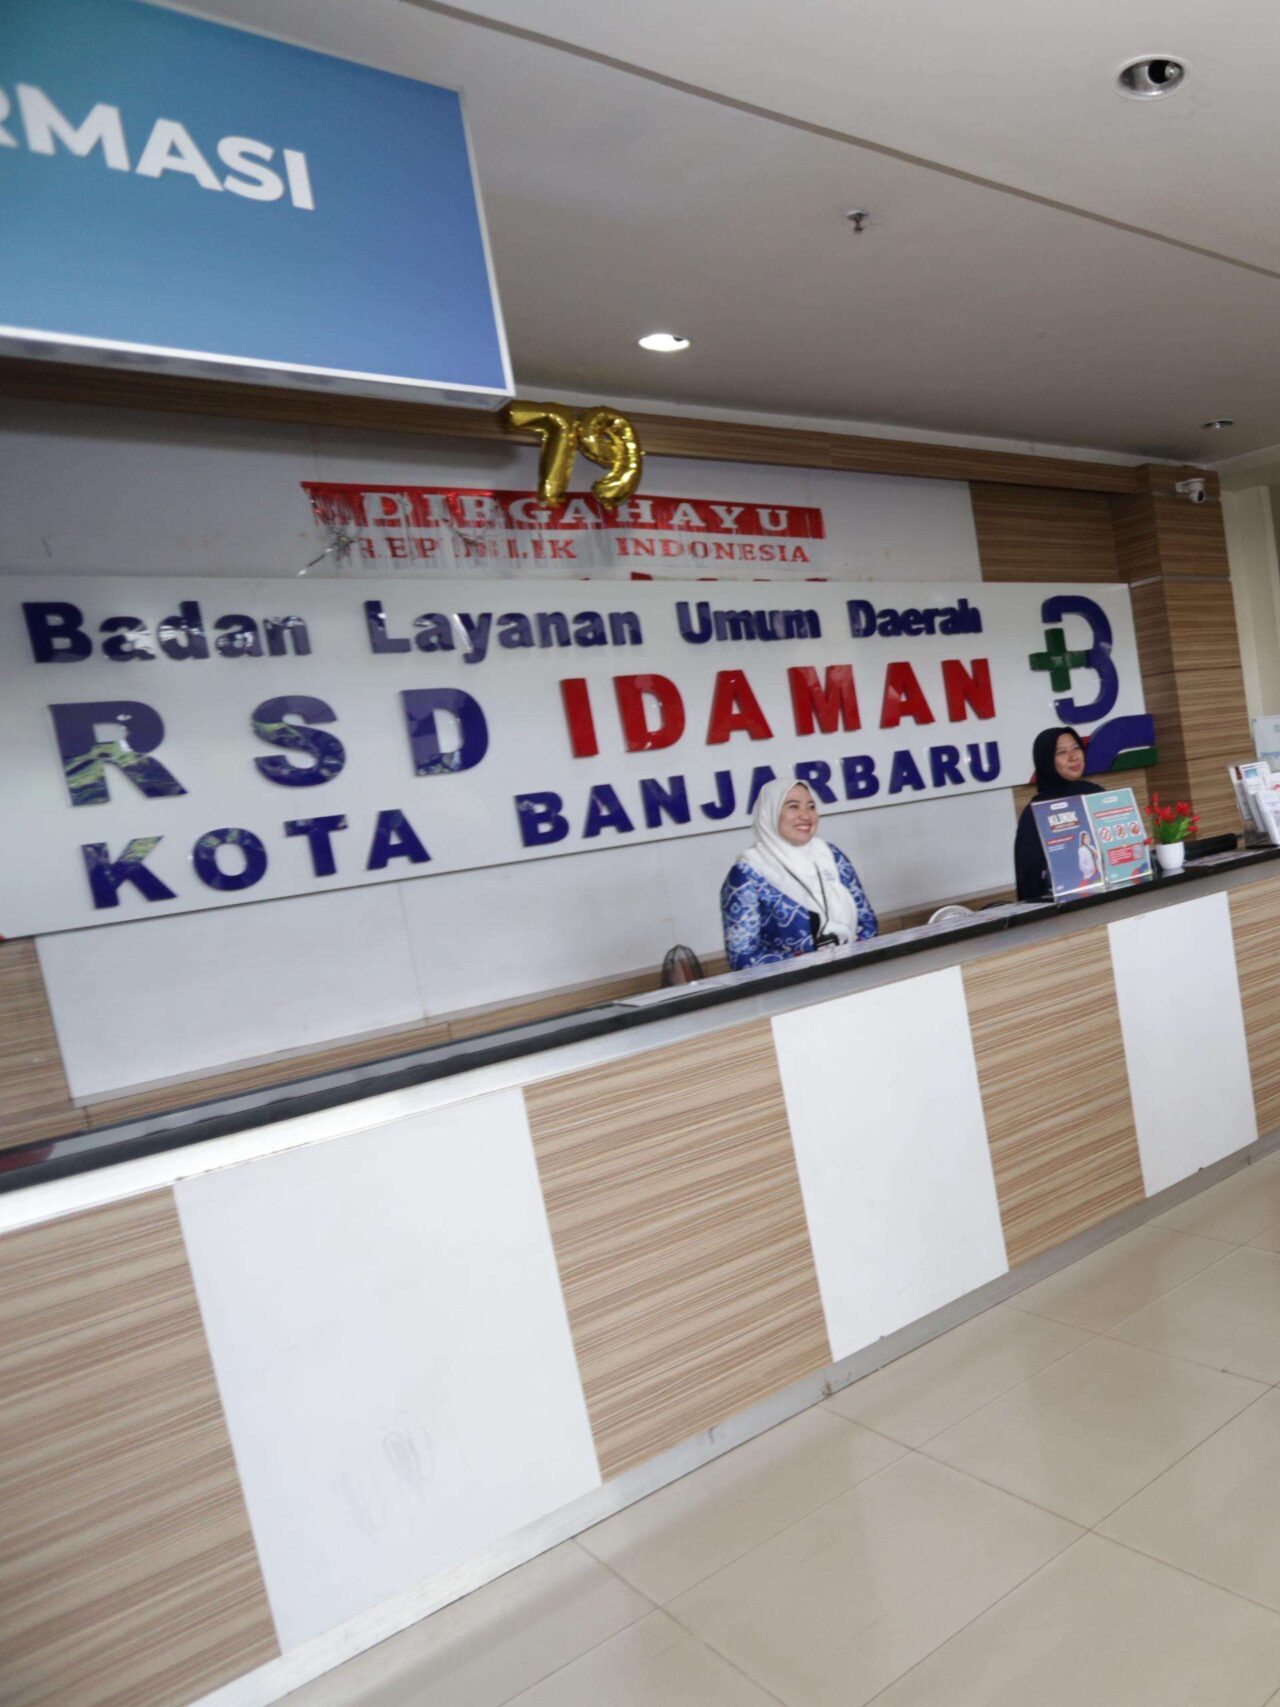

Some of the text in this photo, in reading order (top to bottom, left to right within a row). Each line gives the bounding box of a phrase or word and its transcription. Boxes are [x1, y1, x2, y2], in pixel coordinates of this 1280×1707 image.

[511, 400, 643, 510] 79
[361, 491, 789, 532] DIRGAHAYU
[615, 537, 810, 563] INDONESIA
[22, 598, 984, 664] Badan Layanan Umum Daerah
[46, 658, 998, 807] RSD IDAMAN
[80, 808, 433, 911] KOTA
